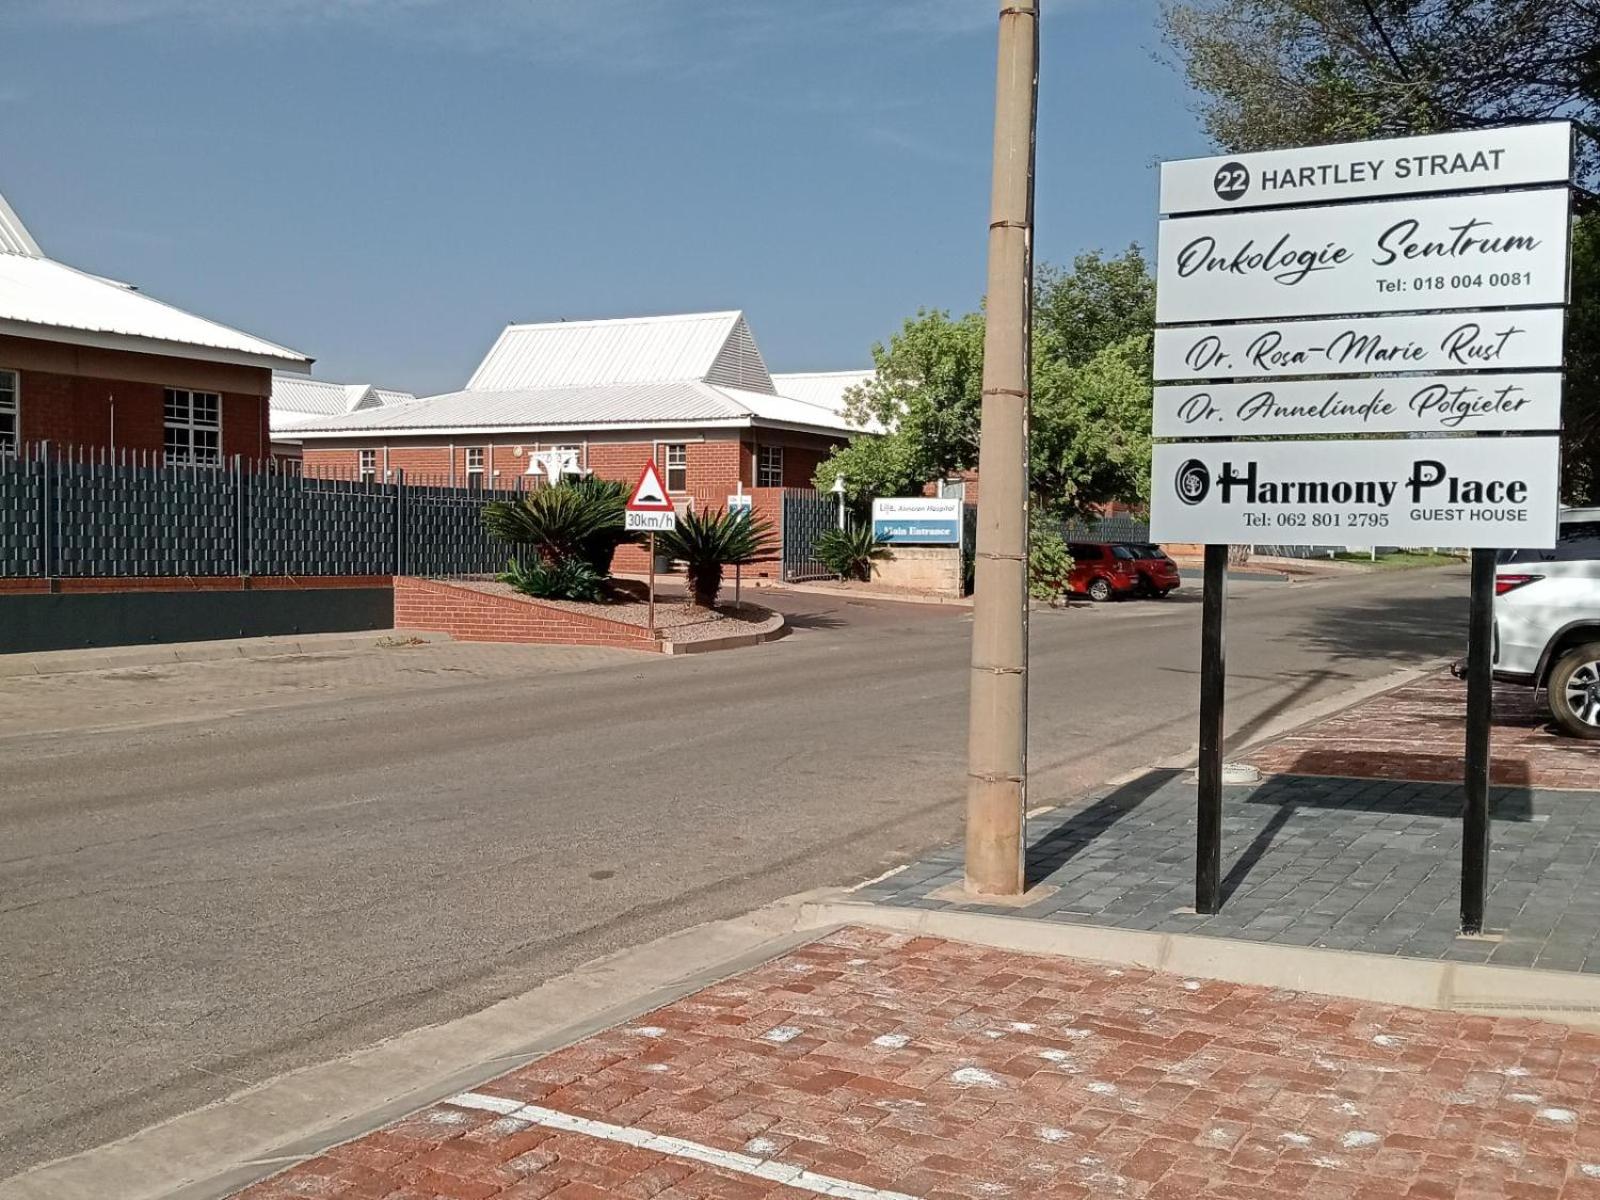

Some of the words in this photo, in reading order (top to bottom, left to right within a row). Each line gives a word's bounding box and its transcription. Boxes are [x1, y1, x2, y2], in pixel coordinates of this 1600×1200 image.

[1217, 170, 1248, 193] 22
[1262, 160, 1385, 190] HARTLEY
[1395, 149, 1505, 178] STRAAT
[1177, 234, 1354, 285] Onkologie
[1372, 218, 1541, 265] Sentrum
[1376, 278, 1407, 293] Tel:
[1413, 276, 1445, 291] 018
[1451, 274, 1482, 289] 004
[1489, 272, 1531, 287] 0081
[1185, 335, 1233, 371] Dr.
[1246, 331, 1428, 371] Rosa-Marie
[1441, 323, 1526, 366] Rust
[1177, 393, 1223, 423] Dr.
[1237, 389, 1397, 422] Annelindie
[1409, 384, 1531, 427] Potgieter
[1216, 461, 1399, 507] Harmony
[1405, 460, 1528, 503] Place
[628, 513, 673, 528] 30km/h
[1243, 513, 1271, 527] Tel:
[1277, 512, 1306, 527] 062
[1311, 512, 1340, 527] 801
[1347, 512, 1389, 527] 2795
[1410, 508, 1464, 521] GUEST
[1470, 508, 1527, 521] HOUSE
[909, 526, 951, 536] Entrance
